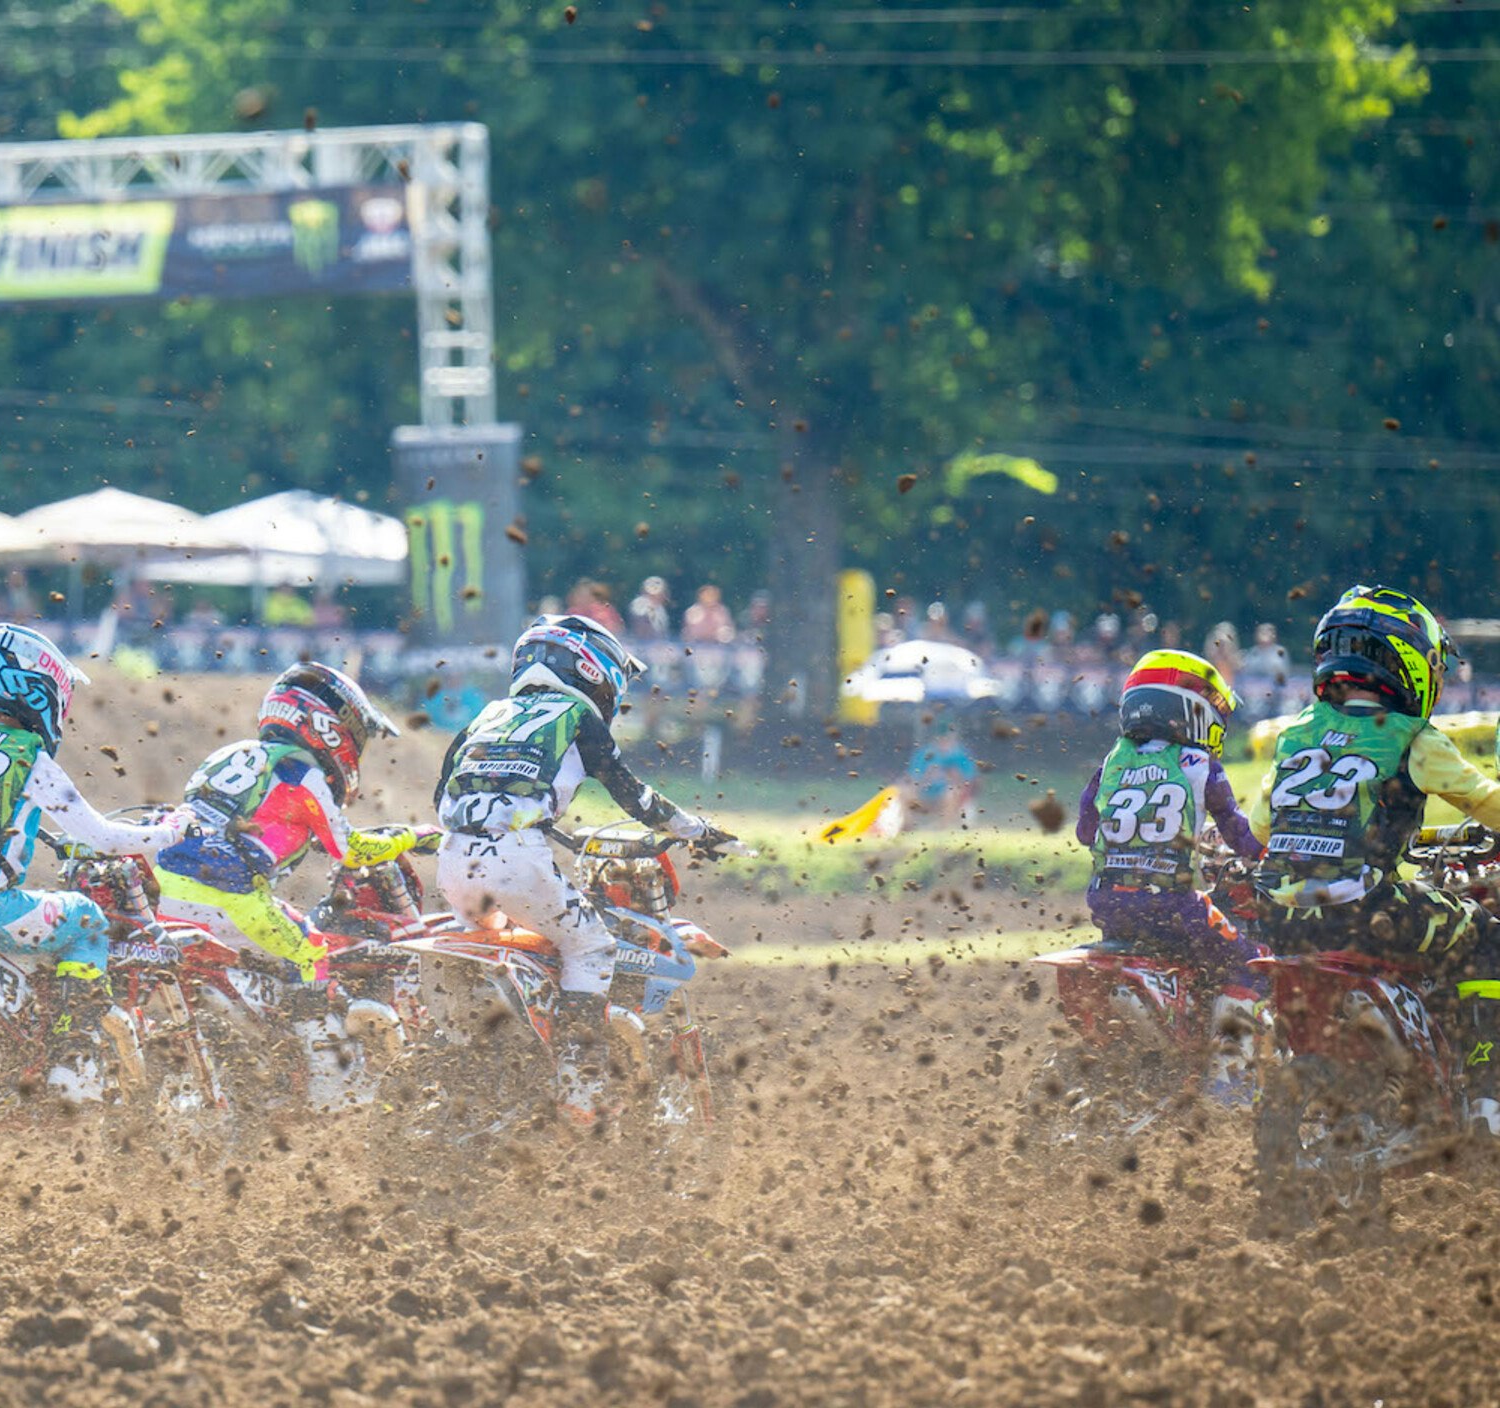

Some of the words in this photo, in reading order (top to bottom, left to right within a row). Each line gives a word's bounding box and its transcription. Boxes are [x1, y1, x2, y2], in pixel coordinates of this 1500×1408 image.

[580, 662, 601, 682] BELL
[466, 700, 578, 743] 27
[1271, 747, 1379, 810] 23
[1102, 783, 1187, 844] 33
